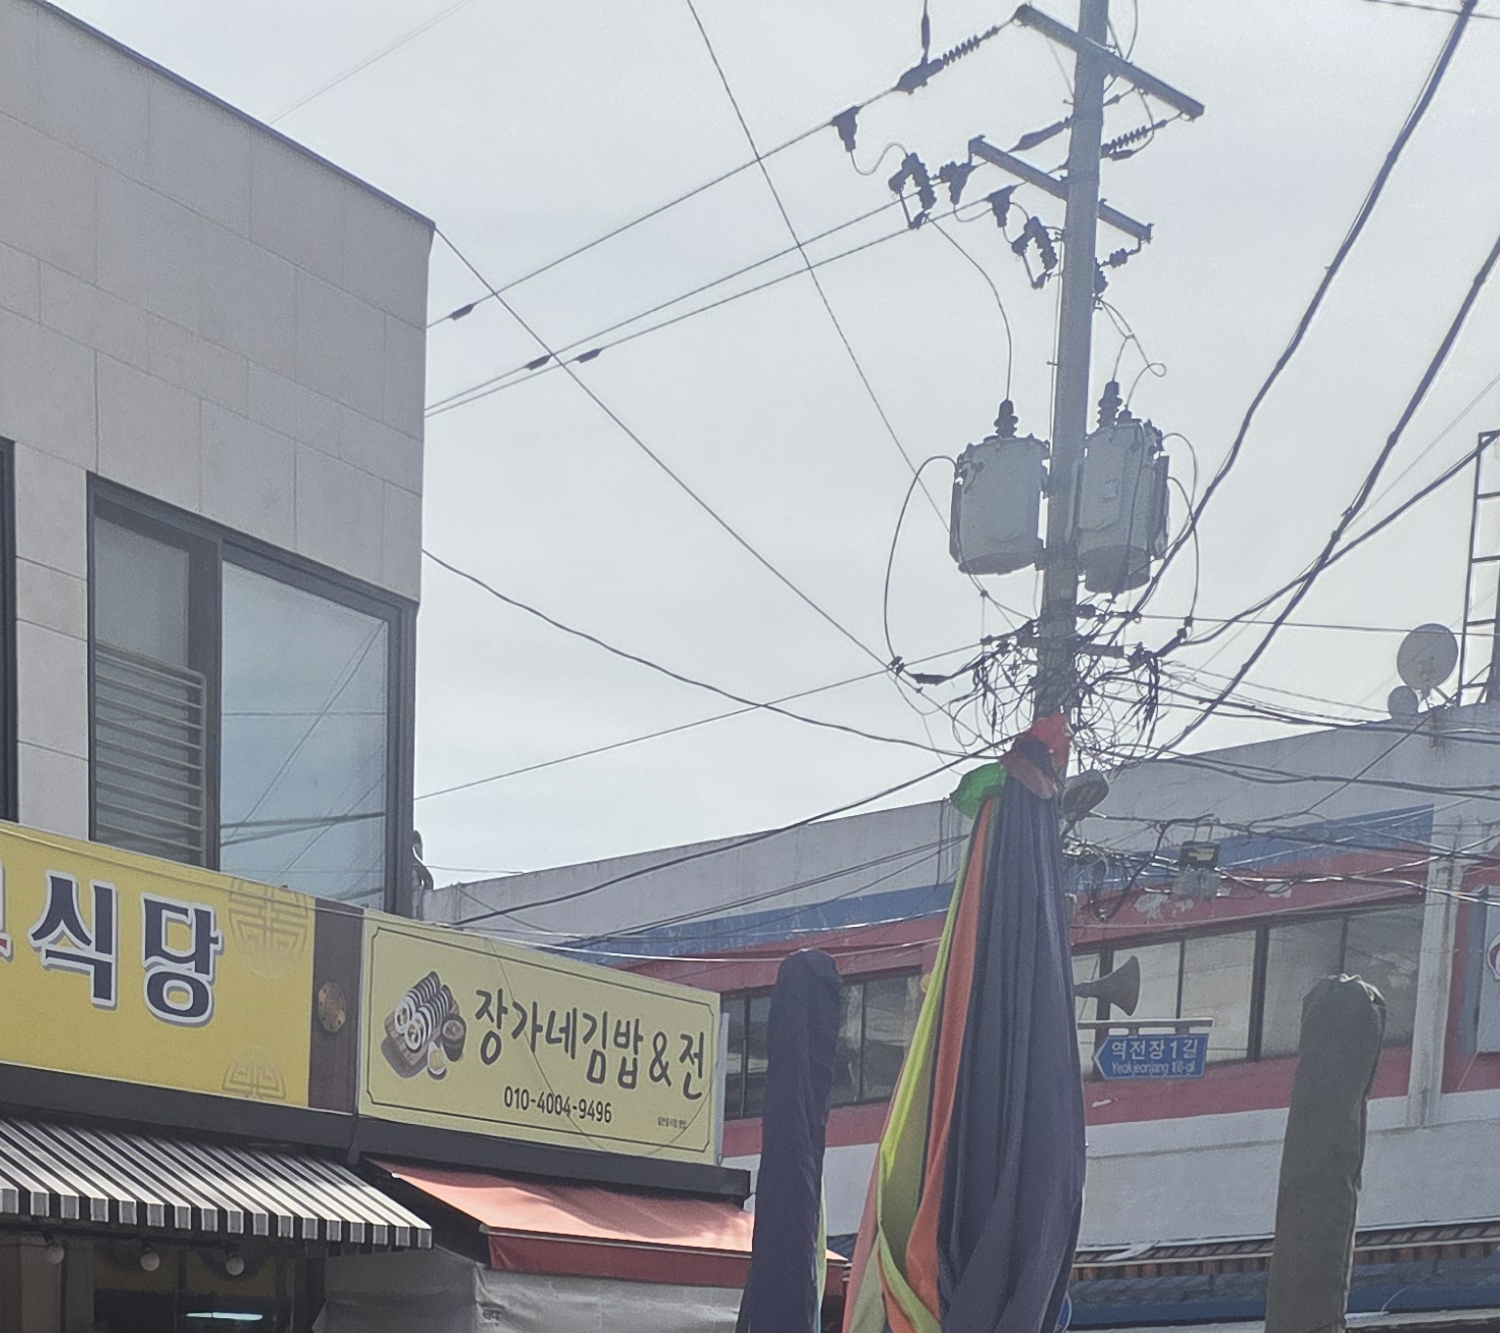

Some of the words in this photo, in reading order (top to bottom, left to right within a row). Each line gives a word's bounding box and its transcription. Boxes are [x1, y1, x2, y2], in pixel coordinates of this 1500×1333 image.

[475, 987, 705, 1101] 장가네김밥&전
[1112, 1039, 1198, 1060] 역전장1길
[503, 1085, 612, 1124] 010-4004-9496
